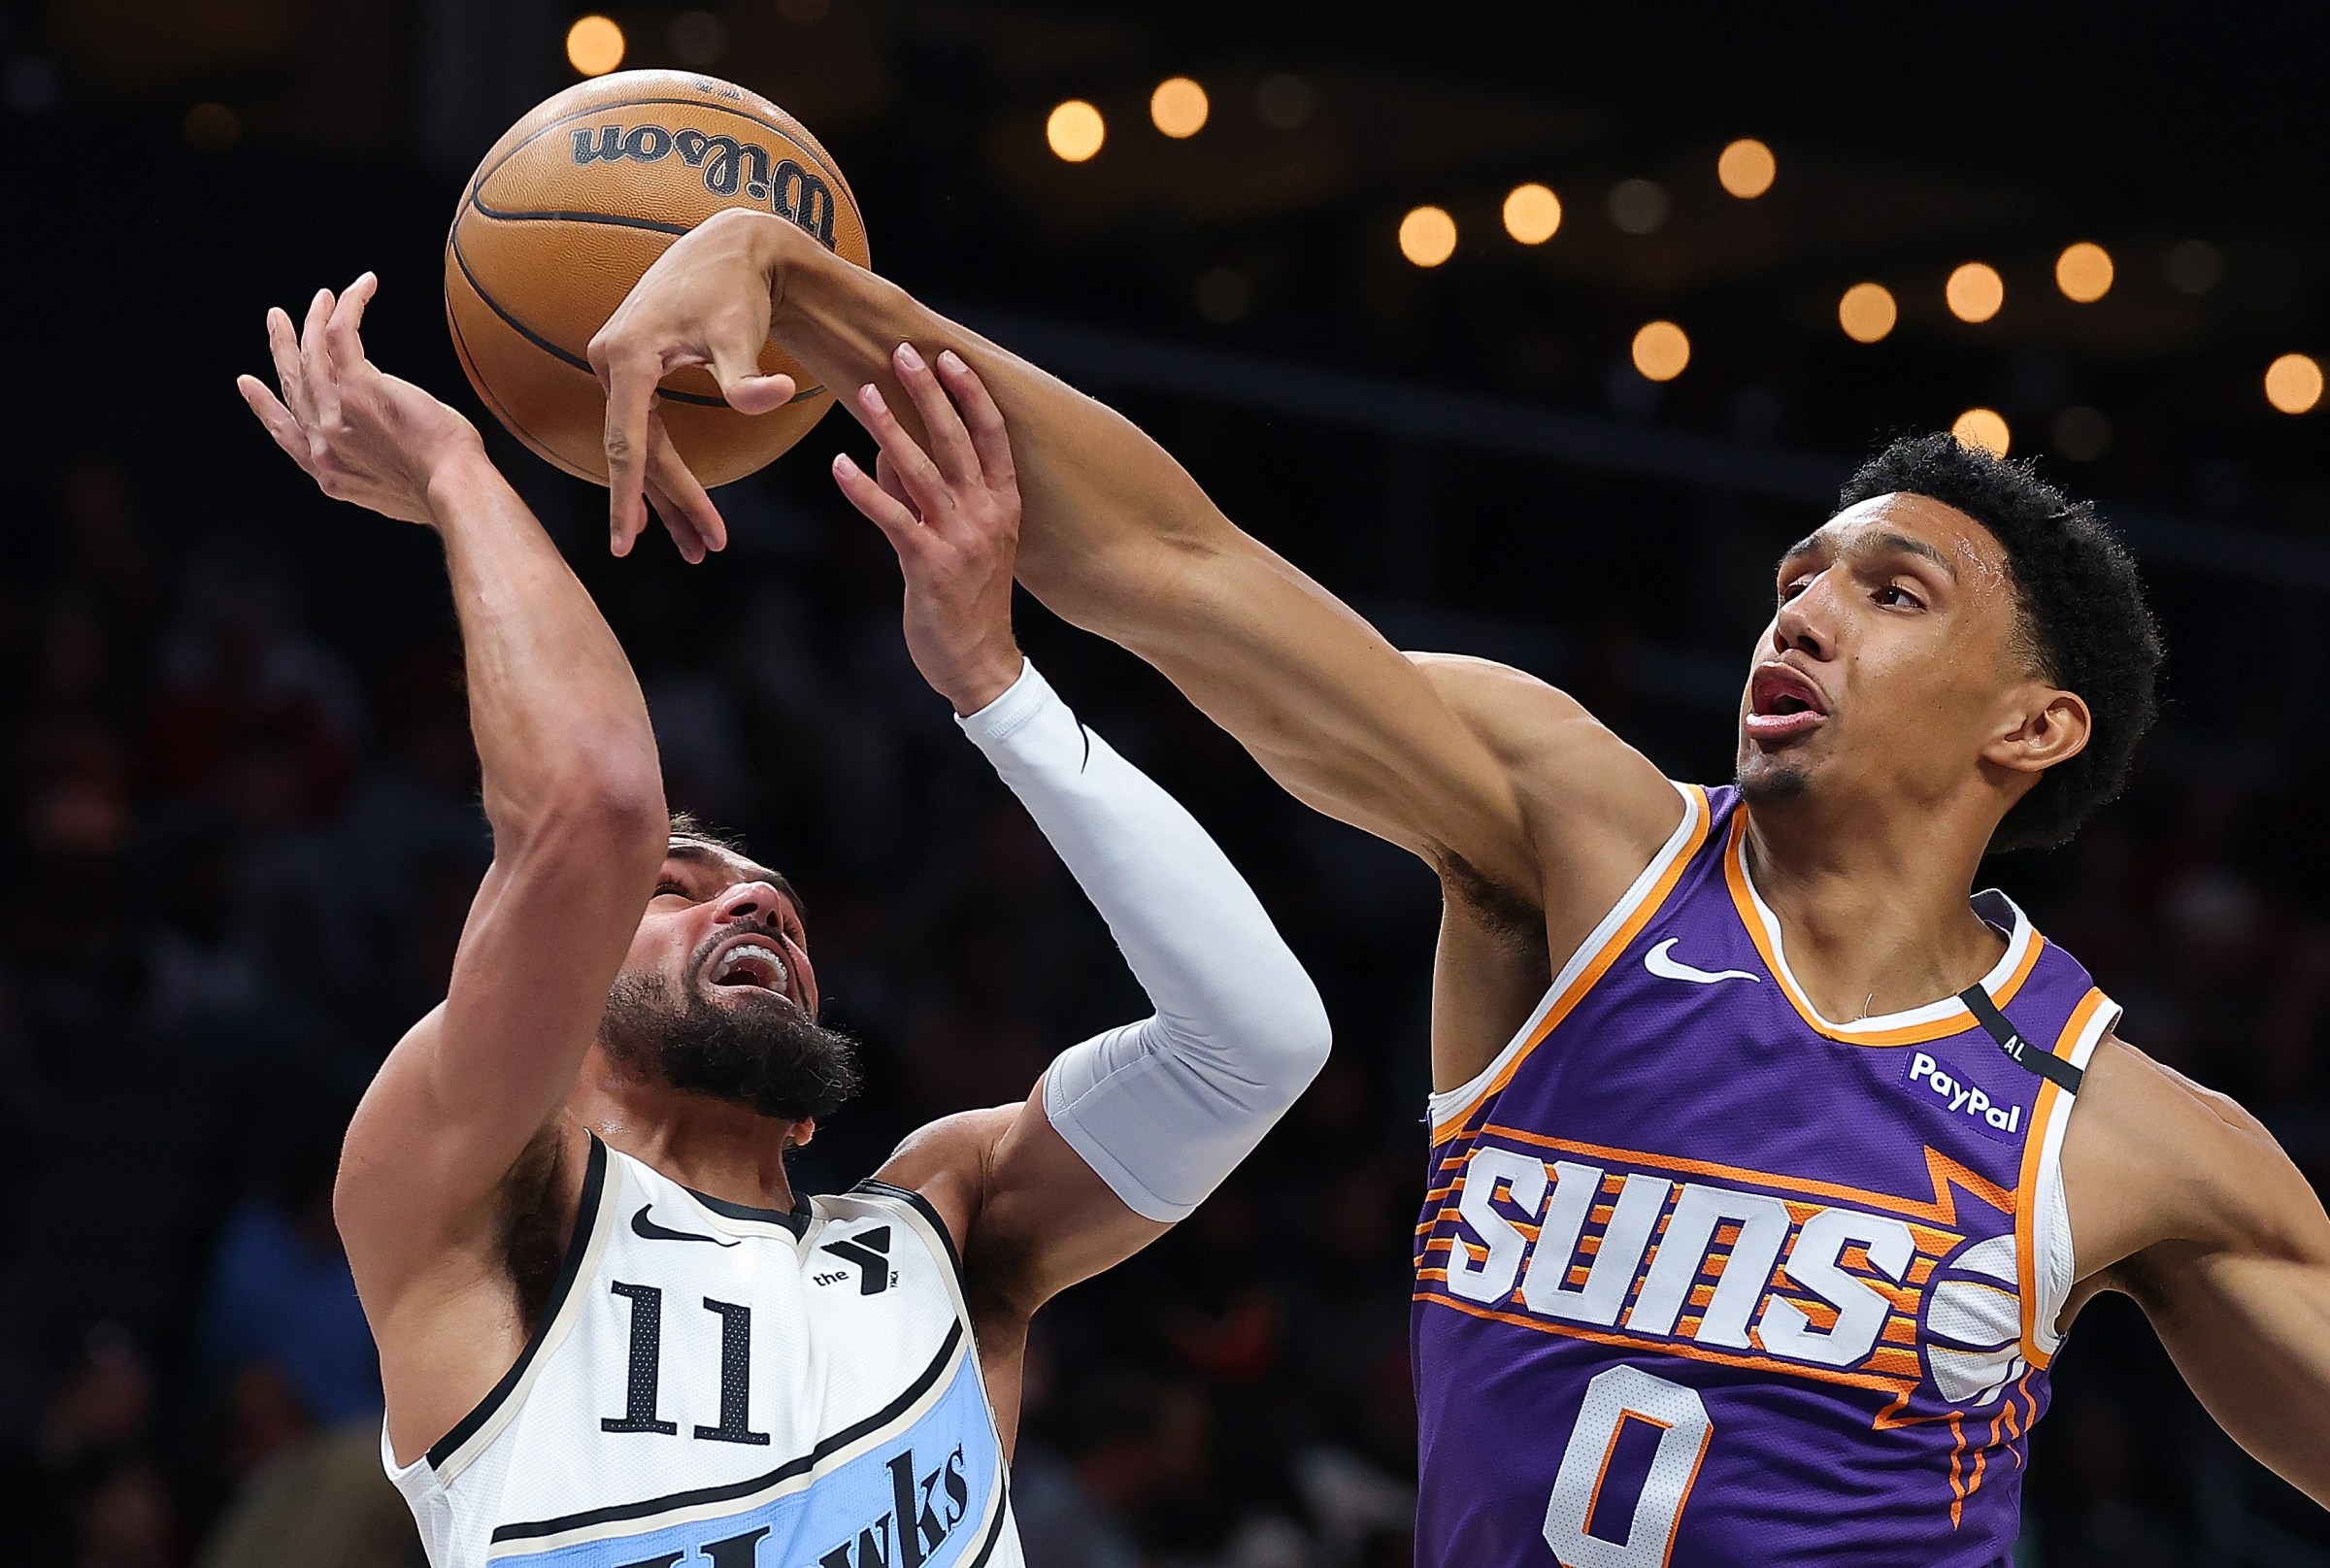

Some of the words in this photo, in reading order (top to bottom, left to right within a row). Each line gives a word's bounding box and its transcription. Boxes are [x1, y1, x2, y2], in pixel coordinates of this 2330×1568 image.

[571, 124, 836, 253] Wilson
[1909, 1051, 2021, 1134] PayPal
[2003, 1034, 2026, 1062] AL
[813, 1270, 849, 1287] the
[600, 1279, 771, 1447] 11
[614, 1442, 970, 1568] wks
[1542, 1363, 1714, 1568] 0
